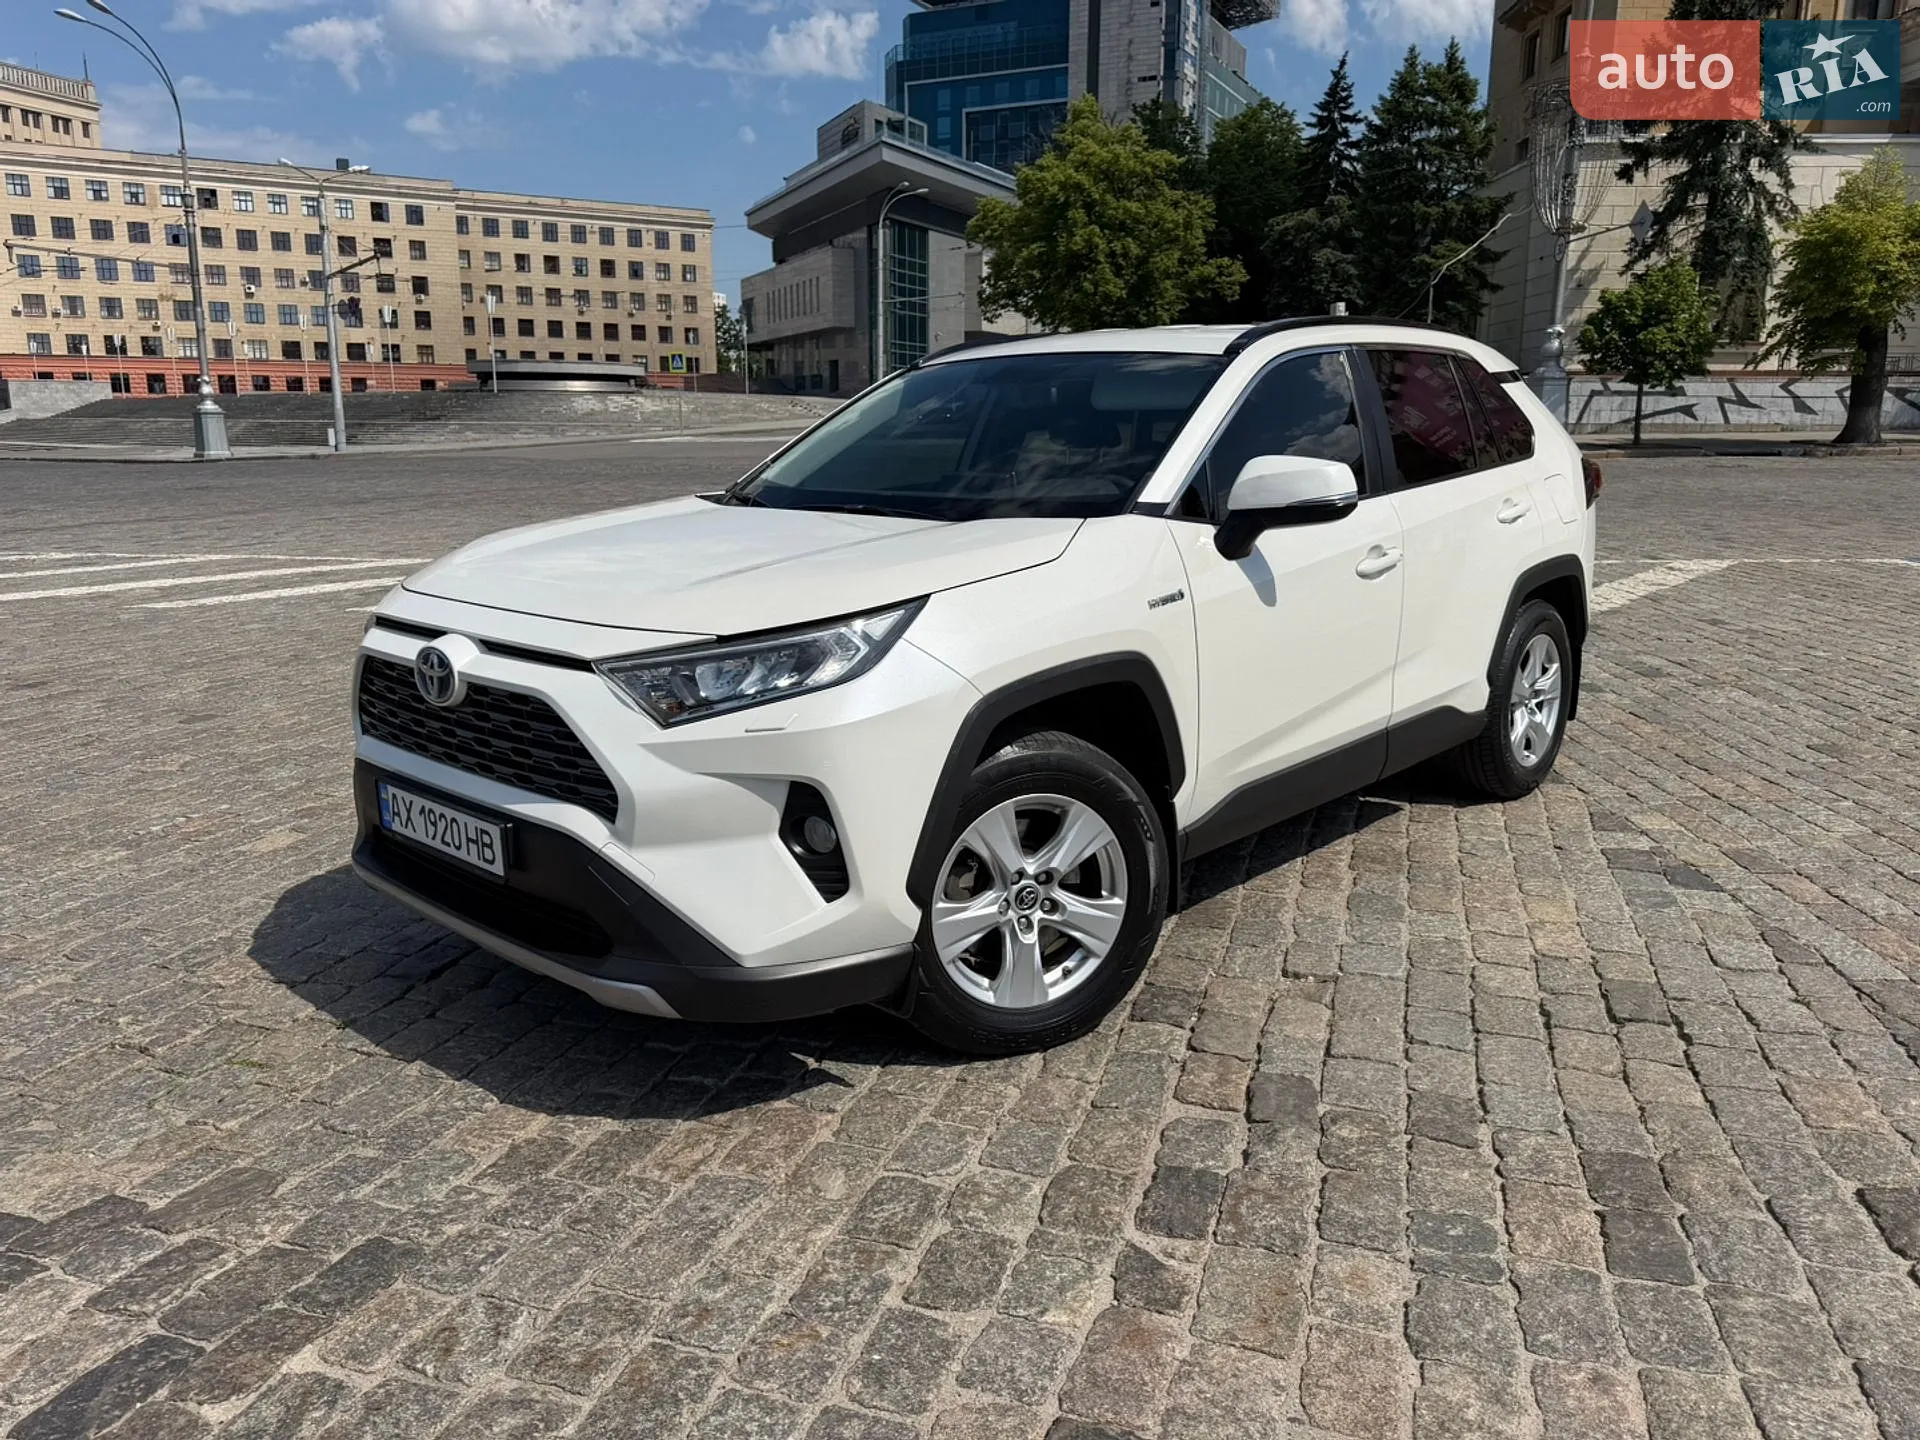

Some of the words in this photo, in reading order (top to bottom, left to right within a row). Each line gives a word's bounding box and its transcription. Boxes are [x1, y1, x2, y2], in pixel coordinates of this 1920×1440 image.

[391, 792, 416, 833] AX
[419, 805, 462, 851] 1920
[464, 821, 495, 865] HB
